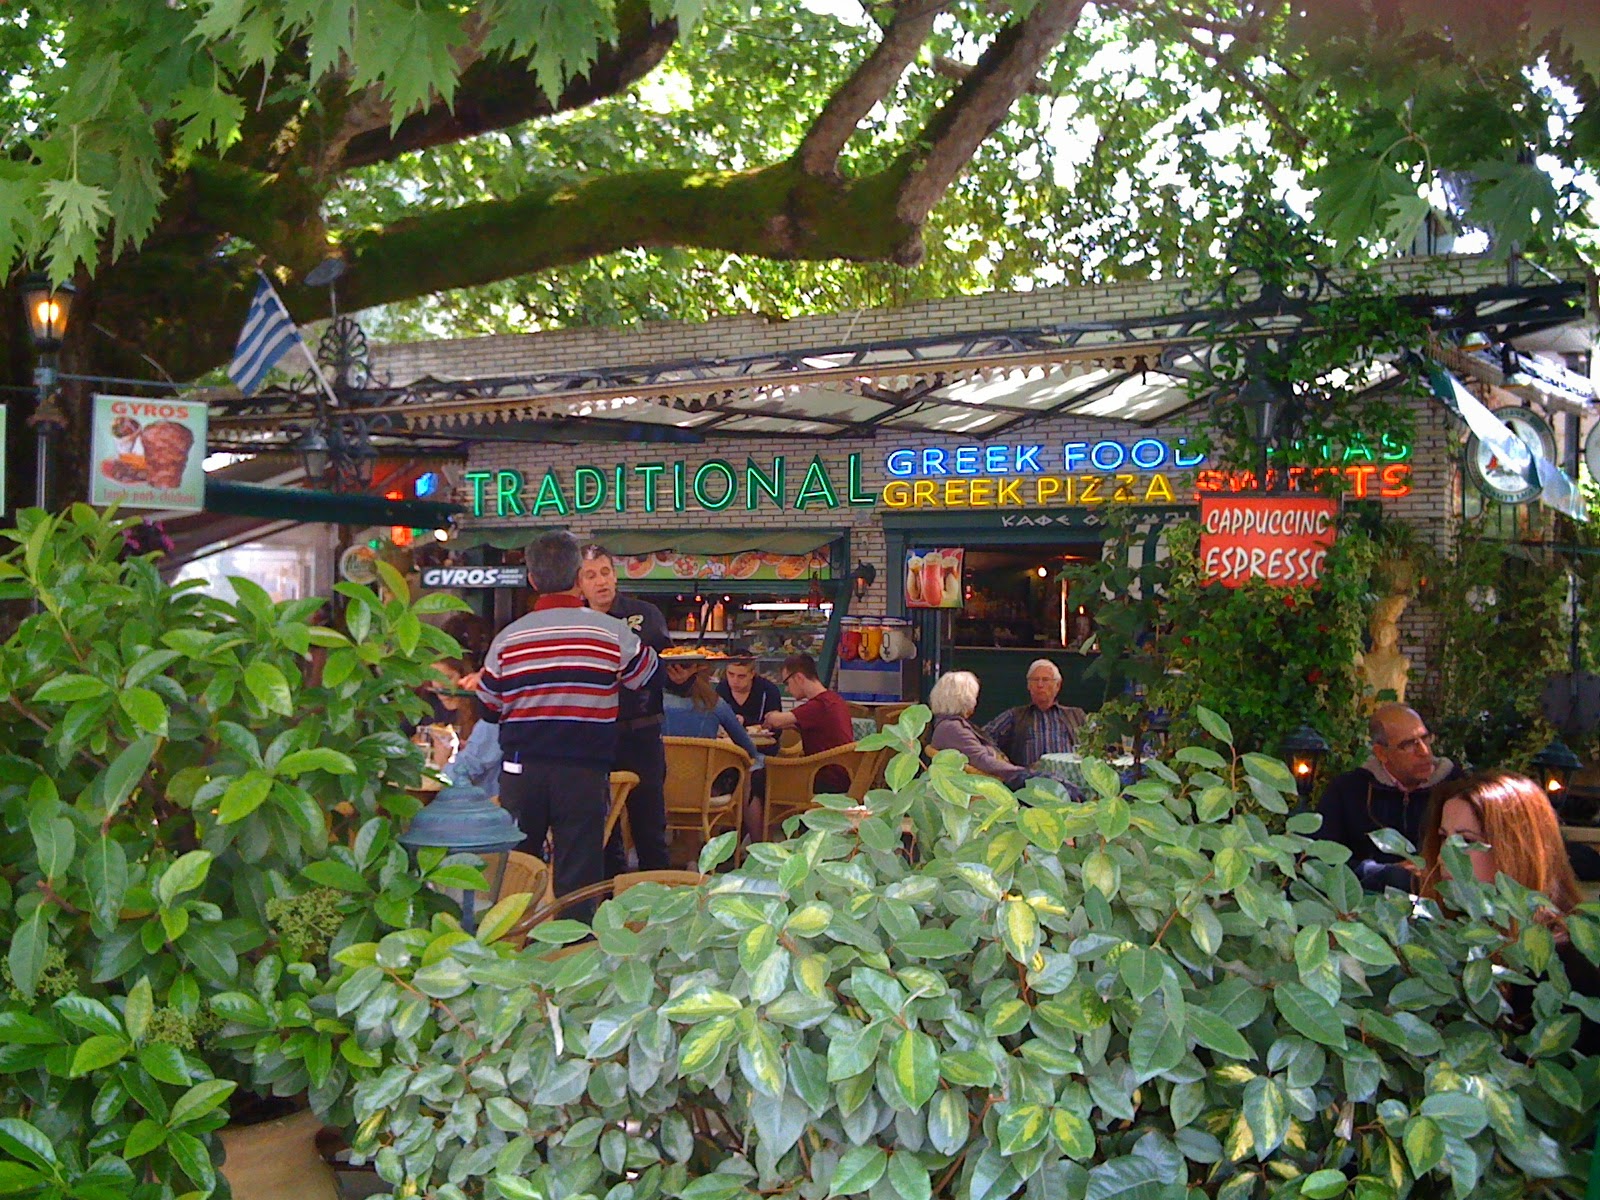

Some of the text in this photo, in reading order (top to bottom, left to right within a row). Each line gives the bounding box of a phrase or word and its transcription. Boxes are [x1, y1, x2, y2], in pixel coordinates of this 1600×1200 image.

[112, 401, 188, 419] GYROS
[887, 446, 1042, 475] GREEK
[465, 453, 878, 517] TRADITIONAL
[883, 474, 1177, 508] GREEK PIZZA
[1196, 463, 1411, 498] SWTS
[1206, 507, 1330, 535] CAPPUCCINO
[424, 569, 499, 586] GYROS
